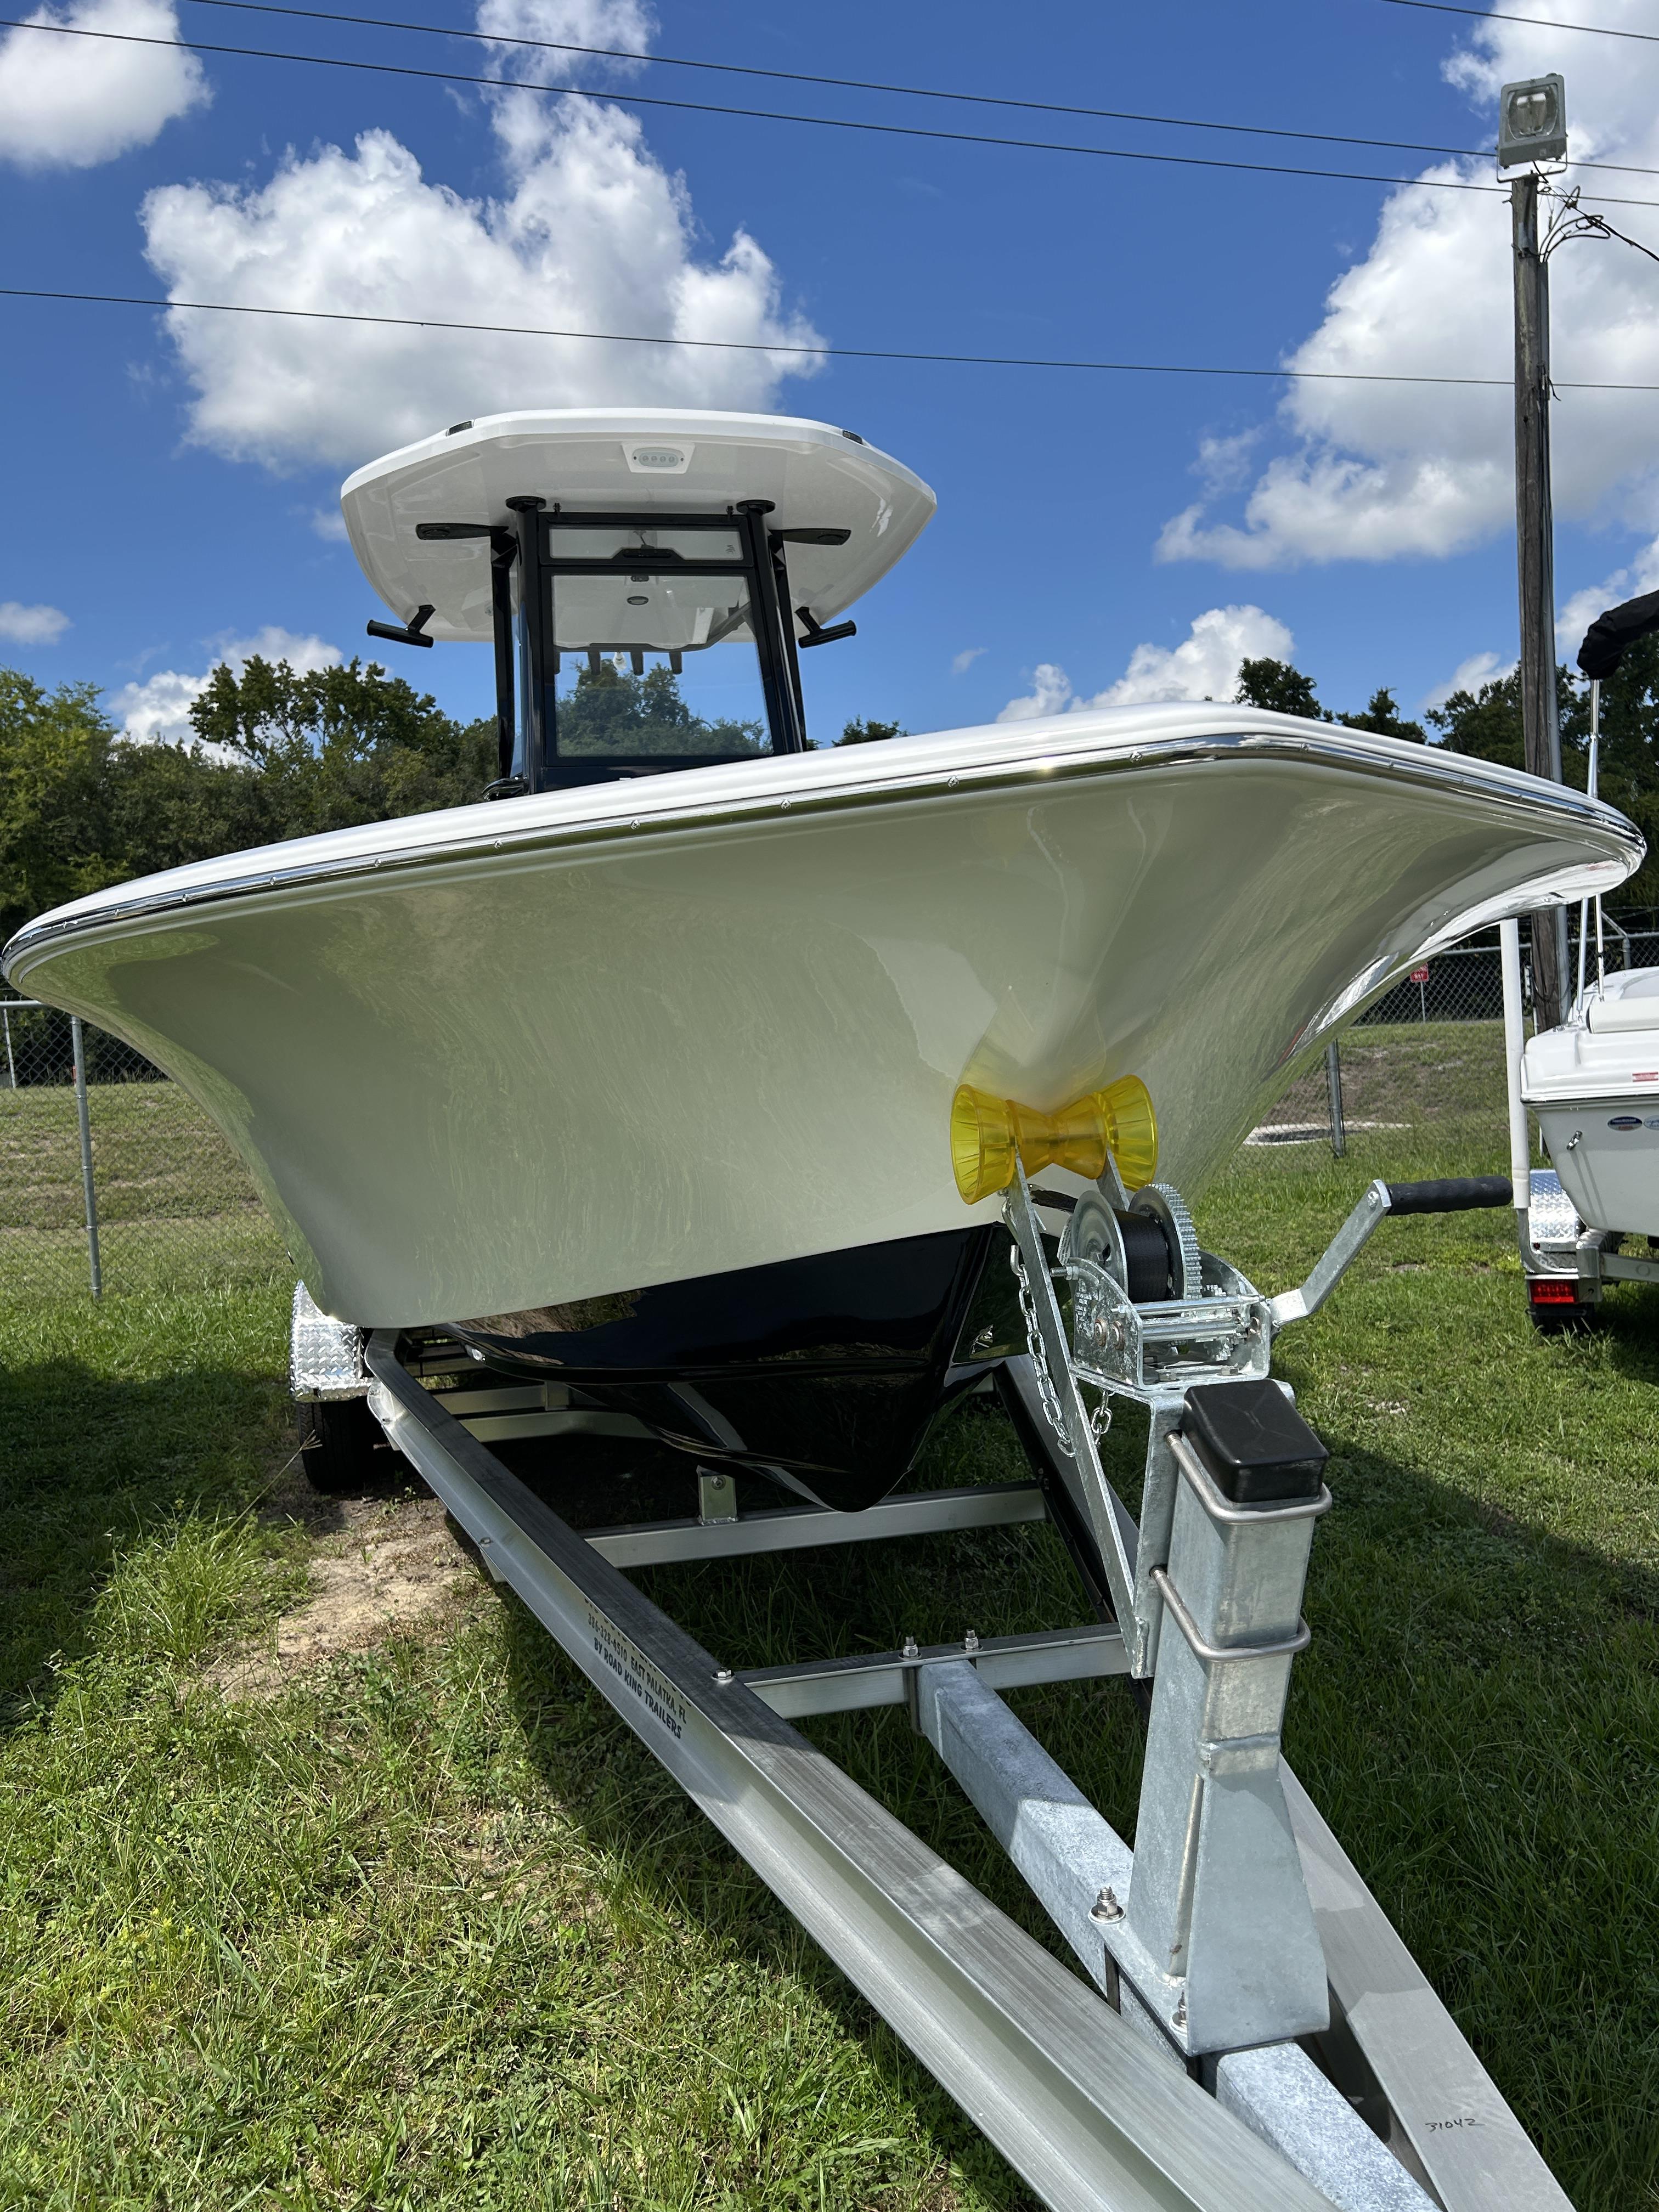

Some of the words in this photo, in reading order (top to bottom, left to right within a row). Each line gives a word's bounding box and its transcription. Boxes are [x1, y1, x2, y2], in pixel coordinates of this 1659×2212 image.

[588, 1613, 627, 1662] 386-328-4510
[631, 1657, 645, 1680] EAST
[647, 1672, 677, 1715] PALATKA,
[679, 1704, 687, 1724] FL
[594, 1637, 602, 1654] BY
[604, 1650, 622, 1676] ROAD
[624, 1669, 642, 1697] KING
[645, 1689, 681, 1739] TRAILERS
[1425, 2118, 1485, 2132] 31042
